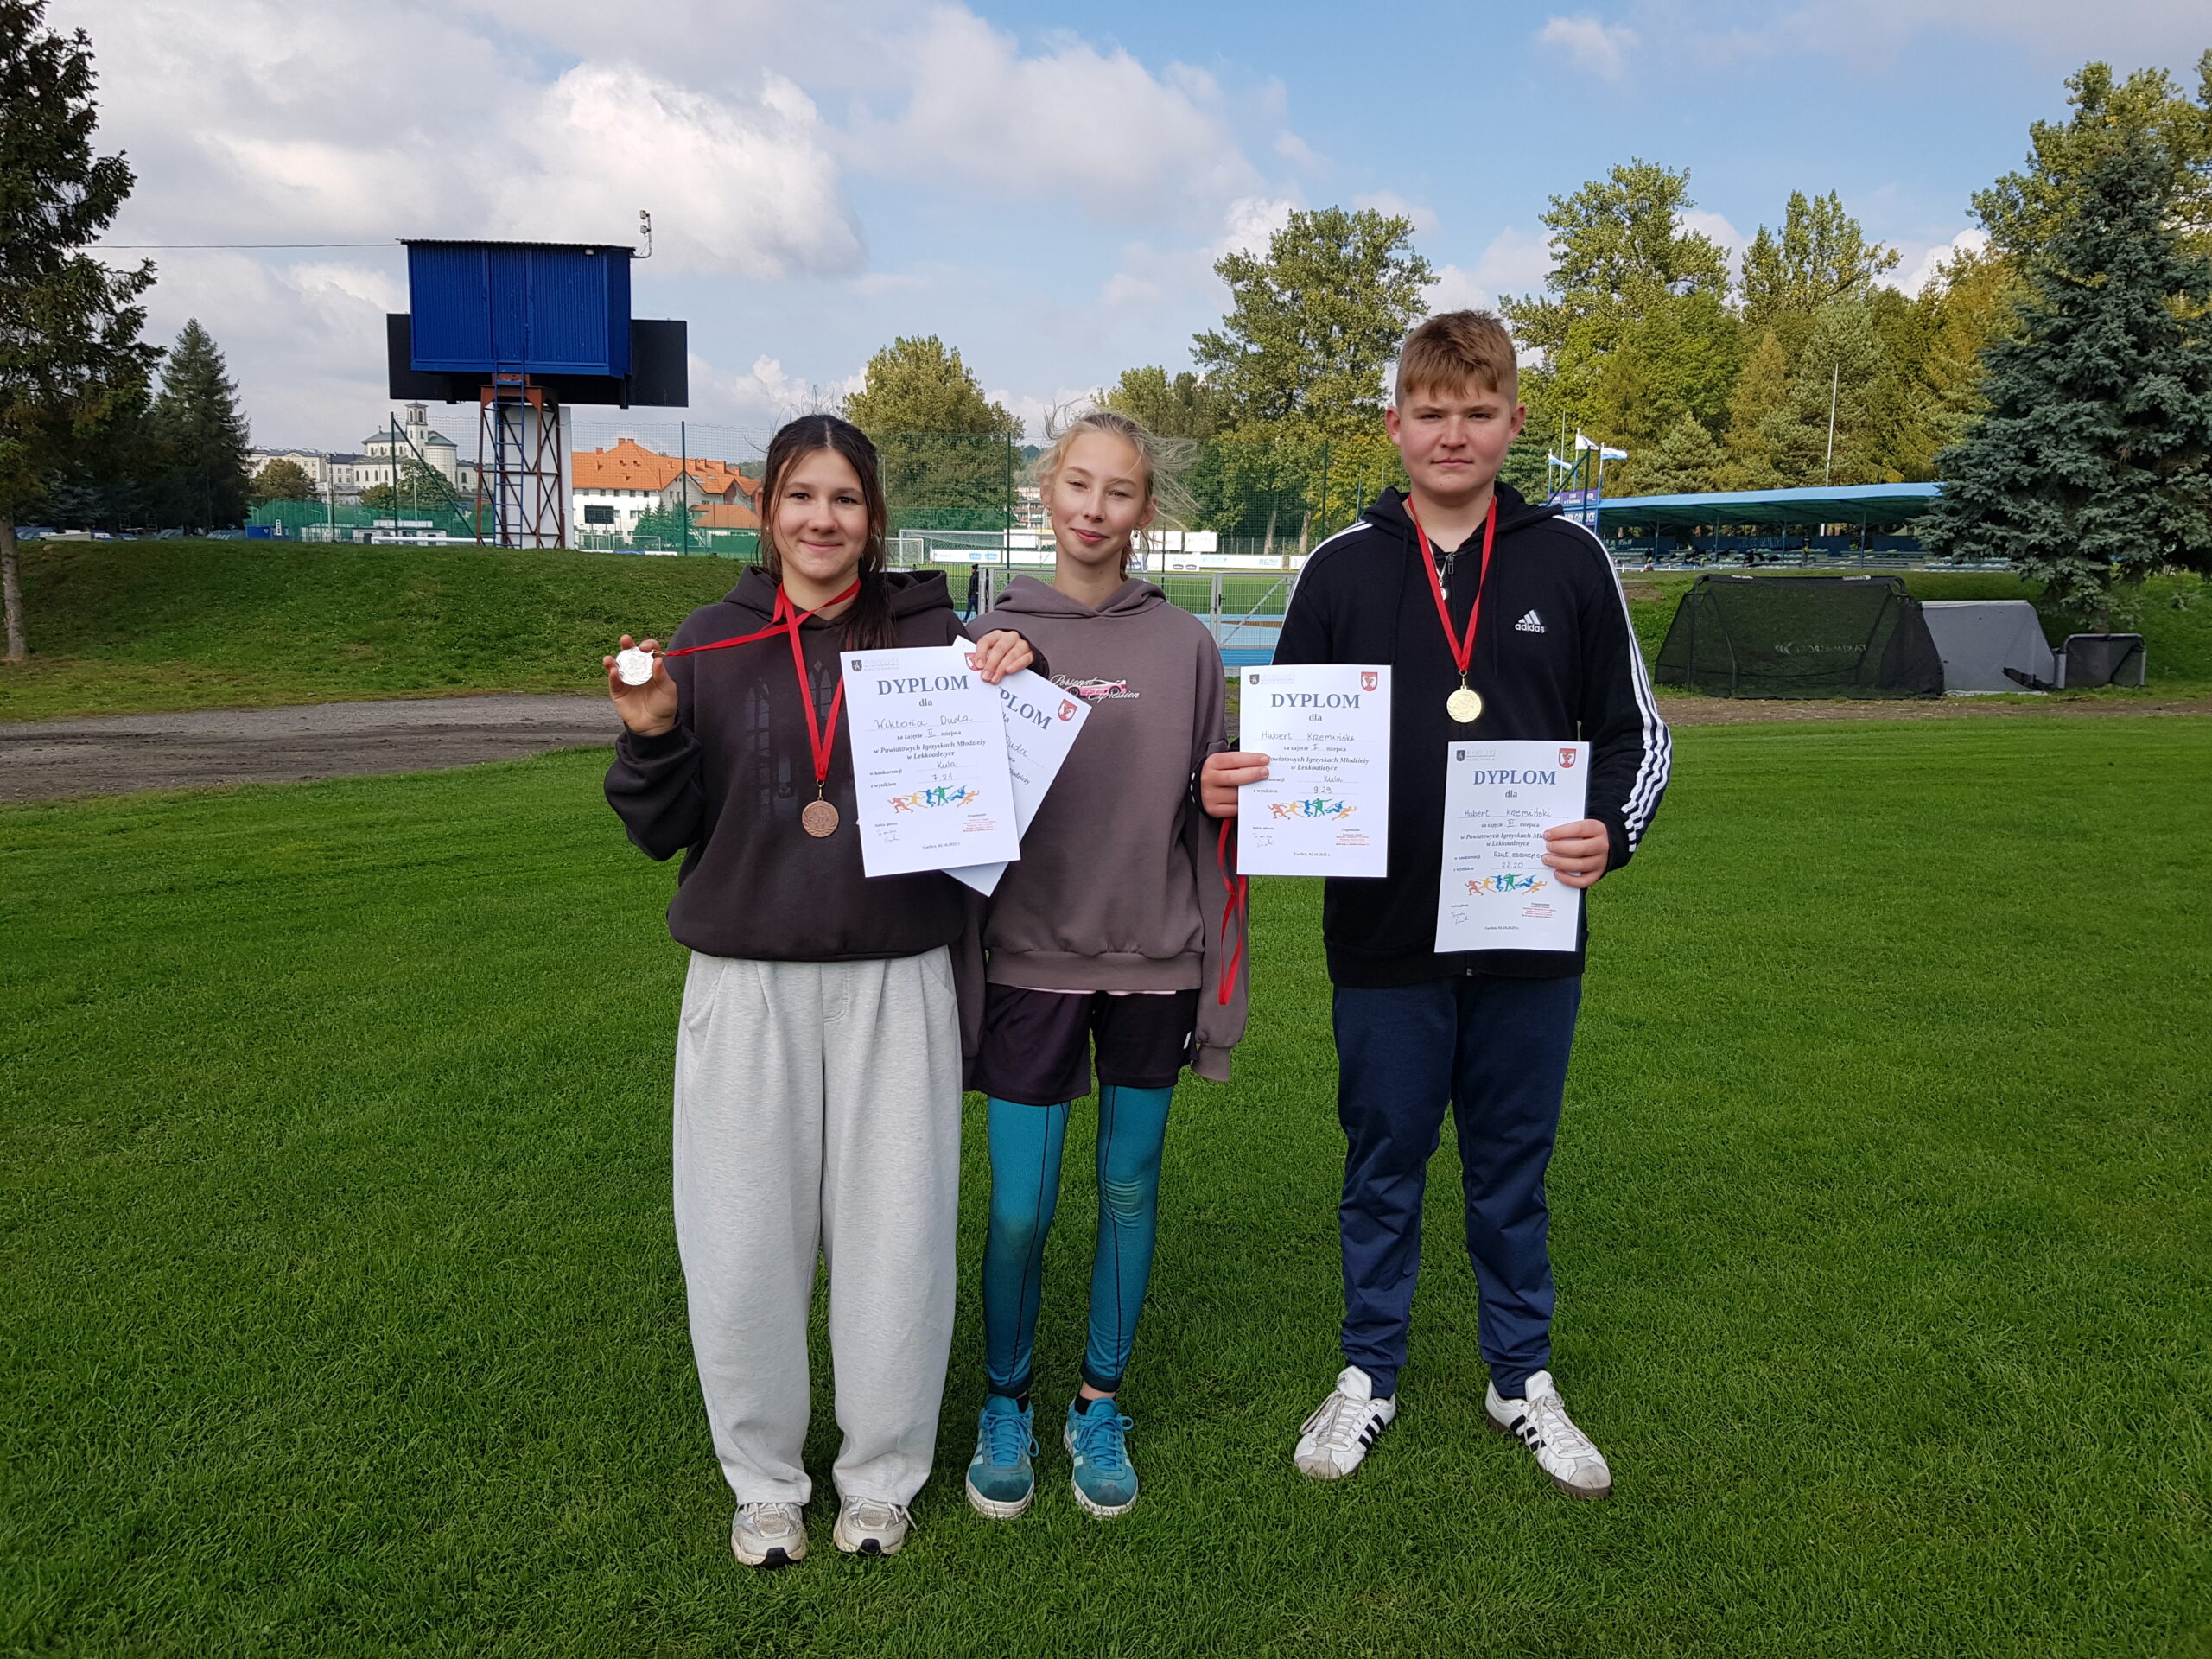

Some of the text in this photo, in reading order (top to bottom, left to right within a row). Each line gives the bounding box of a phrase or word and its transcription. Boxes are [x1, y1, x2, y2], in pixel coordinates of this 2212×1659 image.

[1515, 623, 1545, 633] adidas
[877, 675, 969, 695] DYPLOM
[1050, 674, 1099, 687] Personal
[918, 698, 933, 707] dla
[1271, 693, 1360, 708] DYPLOM
[999, 686, 1052, 731] PLOM
[874, 715, 973, 730] Wiktoria Duda
[1262, 731, 1355, 741] Hubert Krzemiński
[880, 744, 921, 754] Powiatowych
[922, 742, 956, 751] Igrzyskach
[957, 739, 986, 747] Młodzieży
[1006, 734, 1028, 757] Duda
[913, 751, 956, 760] Lekkoatletyce
[1473, 770, 1557, 785] DYPLOM
